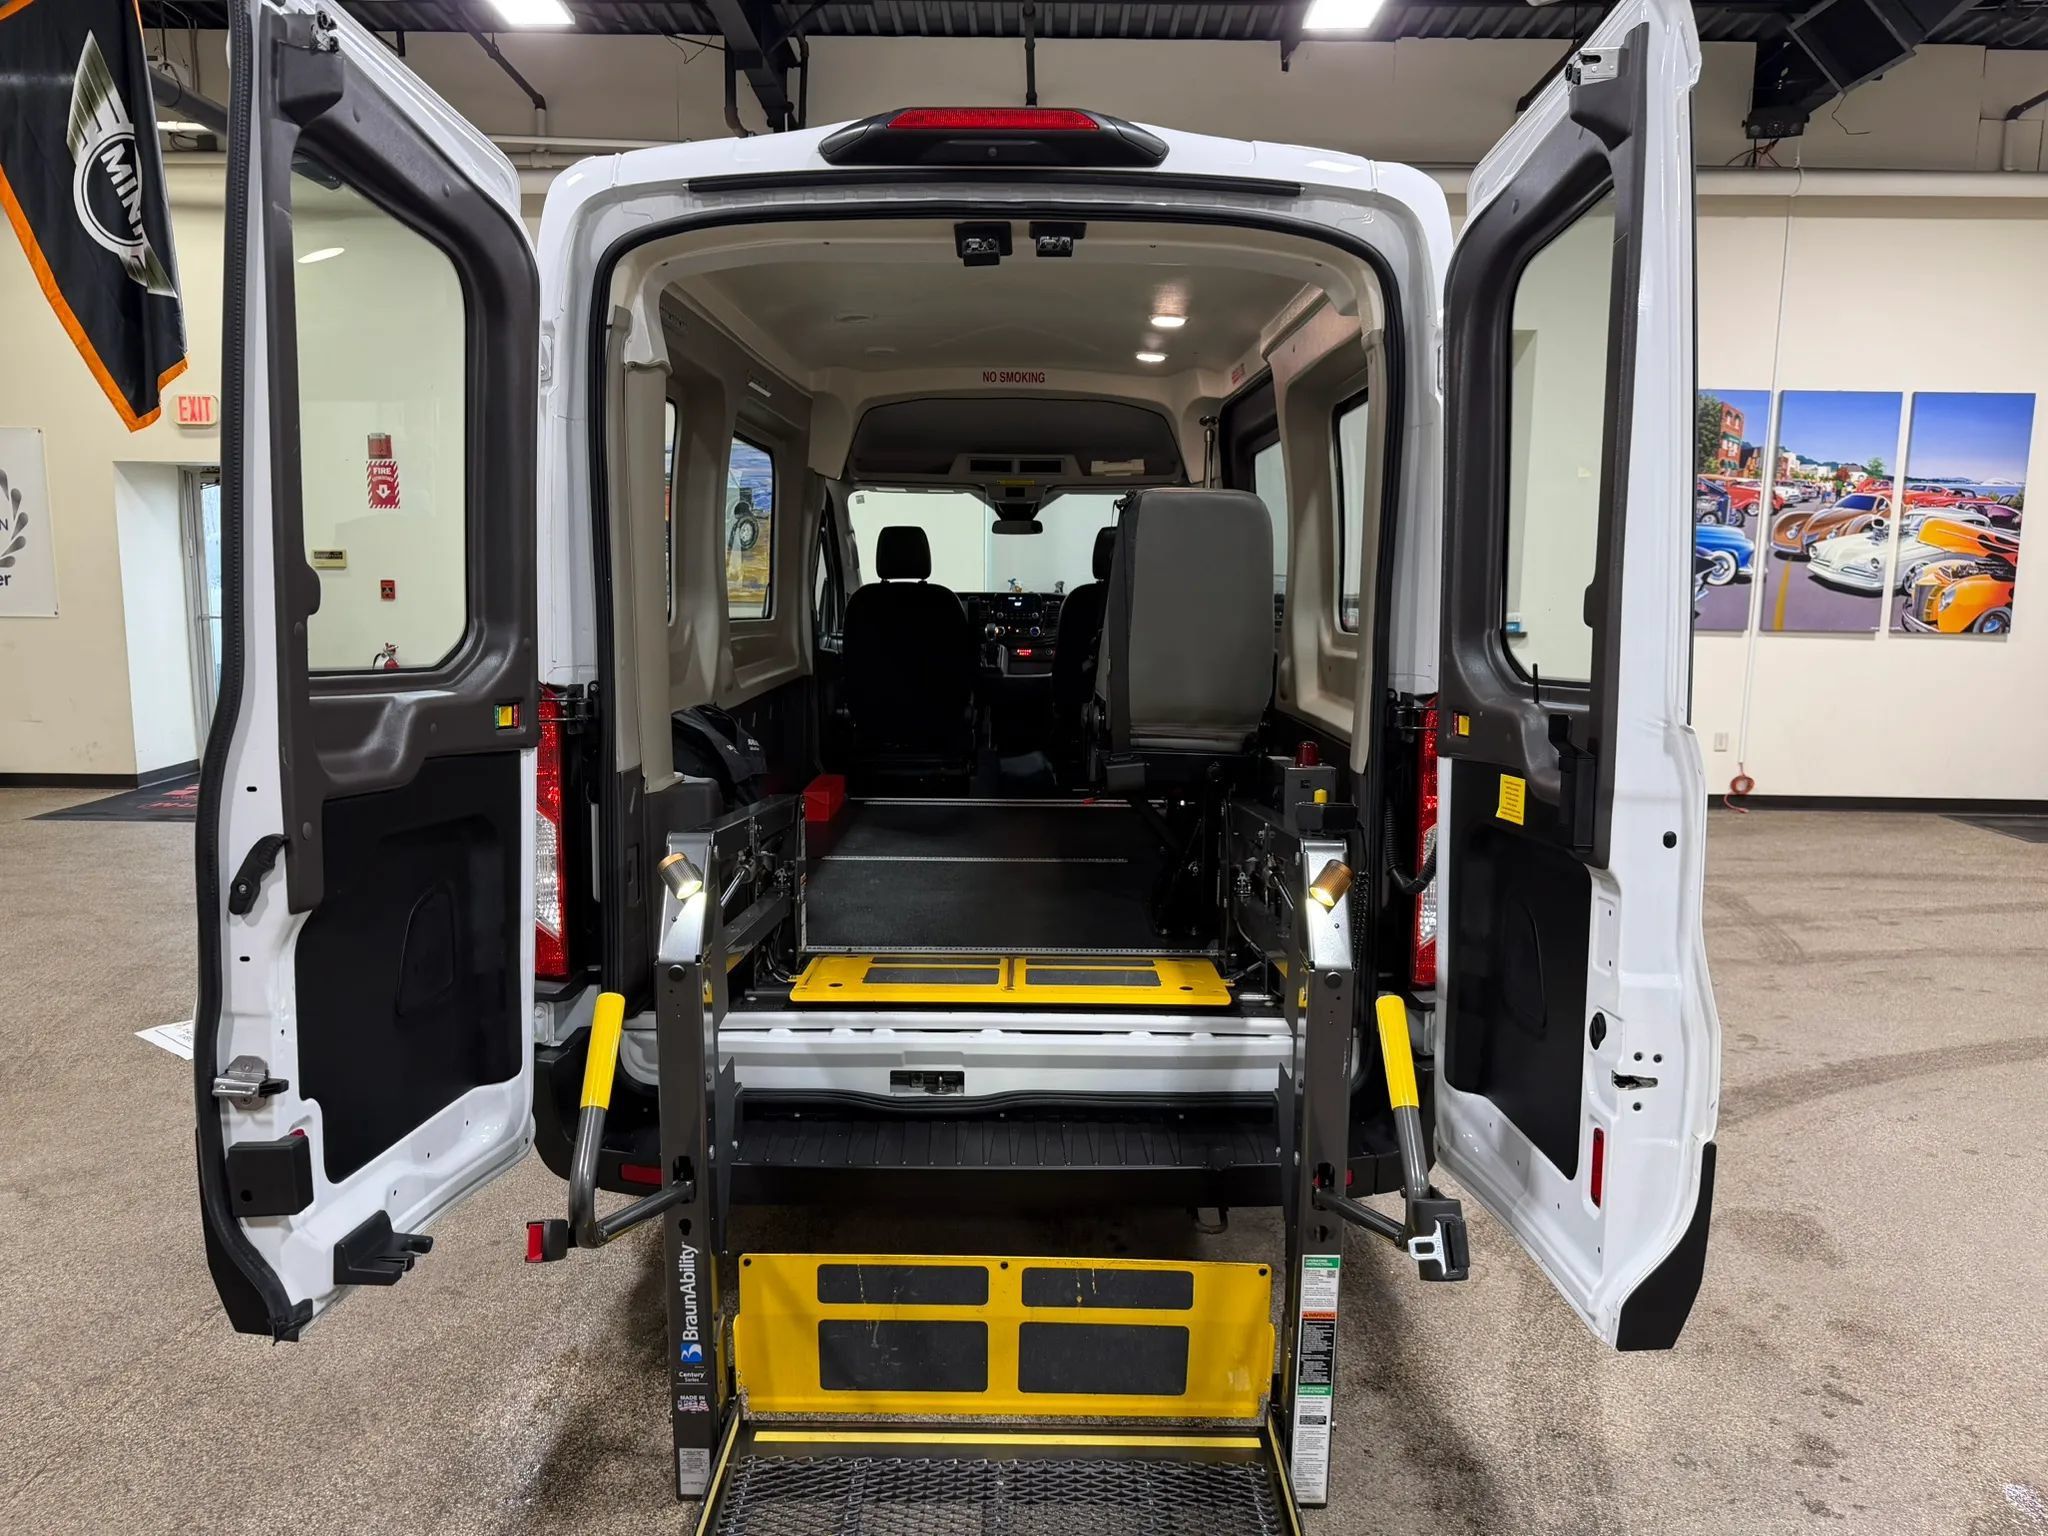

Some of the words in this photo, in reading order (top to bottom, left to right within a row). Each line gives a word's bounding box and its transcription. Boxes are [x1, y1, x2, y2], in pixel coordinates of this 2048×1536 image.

[982, 371, 997, 383] NO
[999, 371, 1045, 383] SMOKING
[178, 396, 211, 422] EXIT
[373, 467, 392, 475] FIRE
[680, 1242, 699, 1341] BraunAbility
